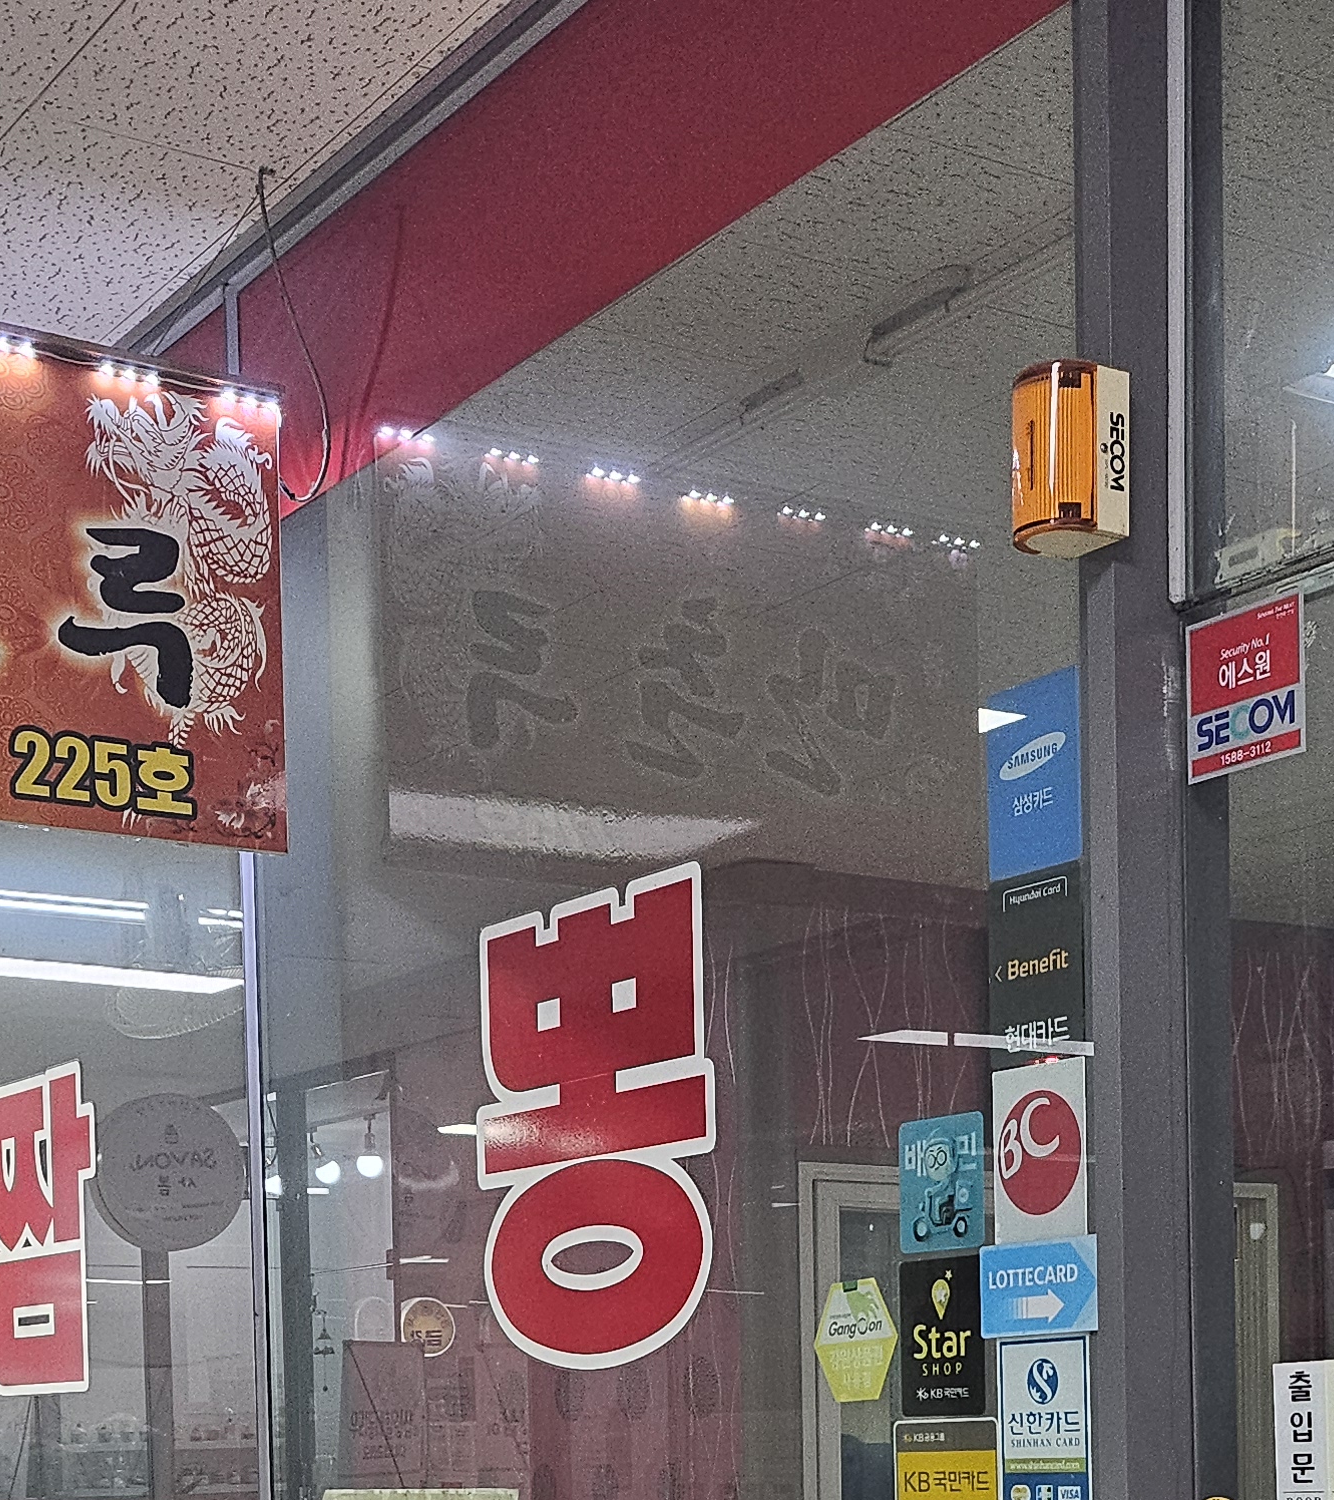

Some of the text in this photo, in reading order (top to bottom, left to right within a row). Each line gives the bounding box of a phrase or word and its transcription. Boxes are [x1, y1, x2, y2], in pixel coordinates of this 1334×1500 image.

[1110, 411, 1125, 492] SECOM
[1220, 642, 1249, 661] Security
[1218, 649, 1271, 690] 에스원
[1196, 689, 1295, 752] SECOM
[1006, 740, 1059, 771] SAMSUNG
[1220, 740, 1272, 767] 1588-3112
[10, 726, 195, 820] 225호
[1012, 786, 1054, 816] 삼성카드
[1009, 882, 1062, 906] Hyundai Card
[1007, 947, 1069, 981] Benefit
[1004, 1015, 1070, 1053] 현대카드
[476, 861, 716, 1370] 뽕
[999, 1097, 1060, 1180] BC
[988, 1263, 1078, 1290] LOTTECARD
[913, 1324, 971, 1360] Star
[922, 1361, 963, 1377] SHOP
[1008, 1411, 1081, 1436] 신한카드
[1288, 1370, 1315, 1484] 출입문
[1011, 1437, 1080, 1448] SHINHAN CARD
[1060, 1488, 1080, 1500] VISA
